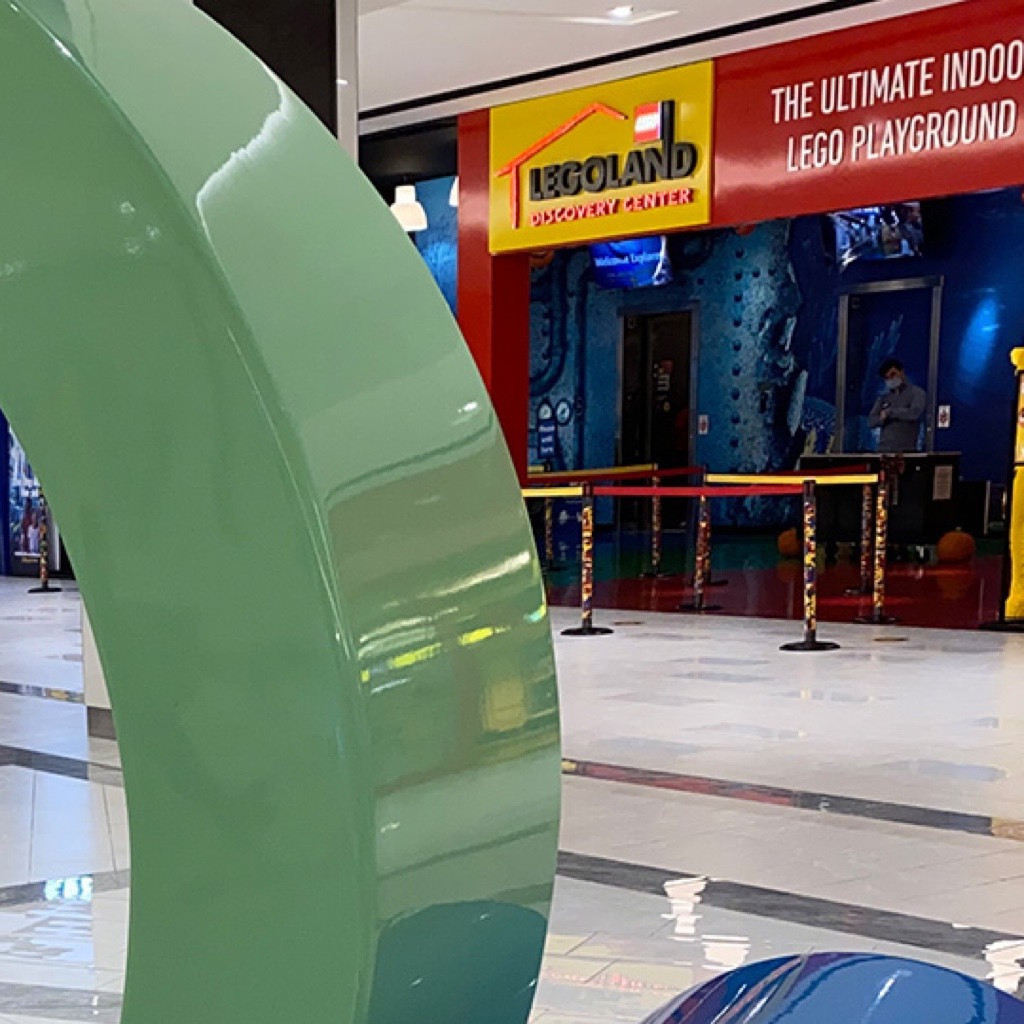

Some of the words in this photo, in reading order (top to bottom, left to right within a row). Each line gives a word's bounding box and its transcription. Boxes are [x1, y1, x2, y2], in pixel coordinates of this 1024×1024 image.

[772, 82, 814, 123] THE
[820, 57, 935, 114] ULTIMATE
[787, 129, 843, 172] LEGO
[851, 99, 1016, 162] PLAYGROUND
[529, 140, 698, 201] LEGOLAND
[530, 199, 620, 227] DISCOVERY
[624, 188, 695, 212] CENTER
